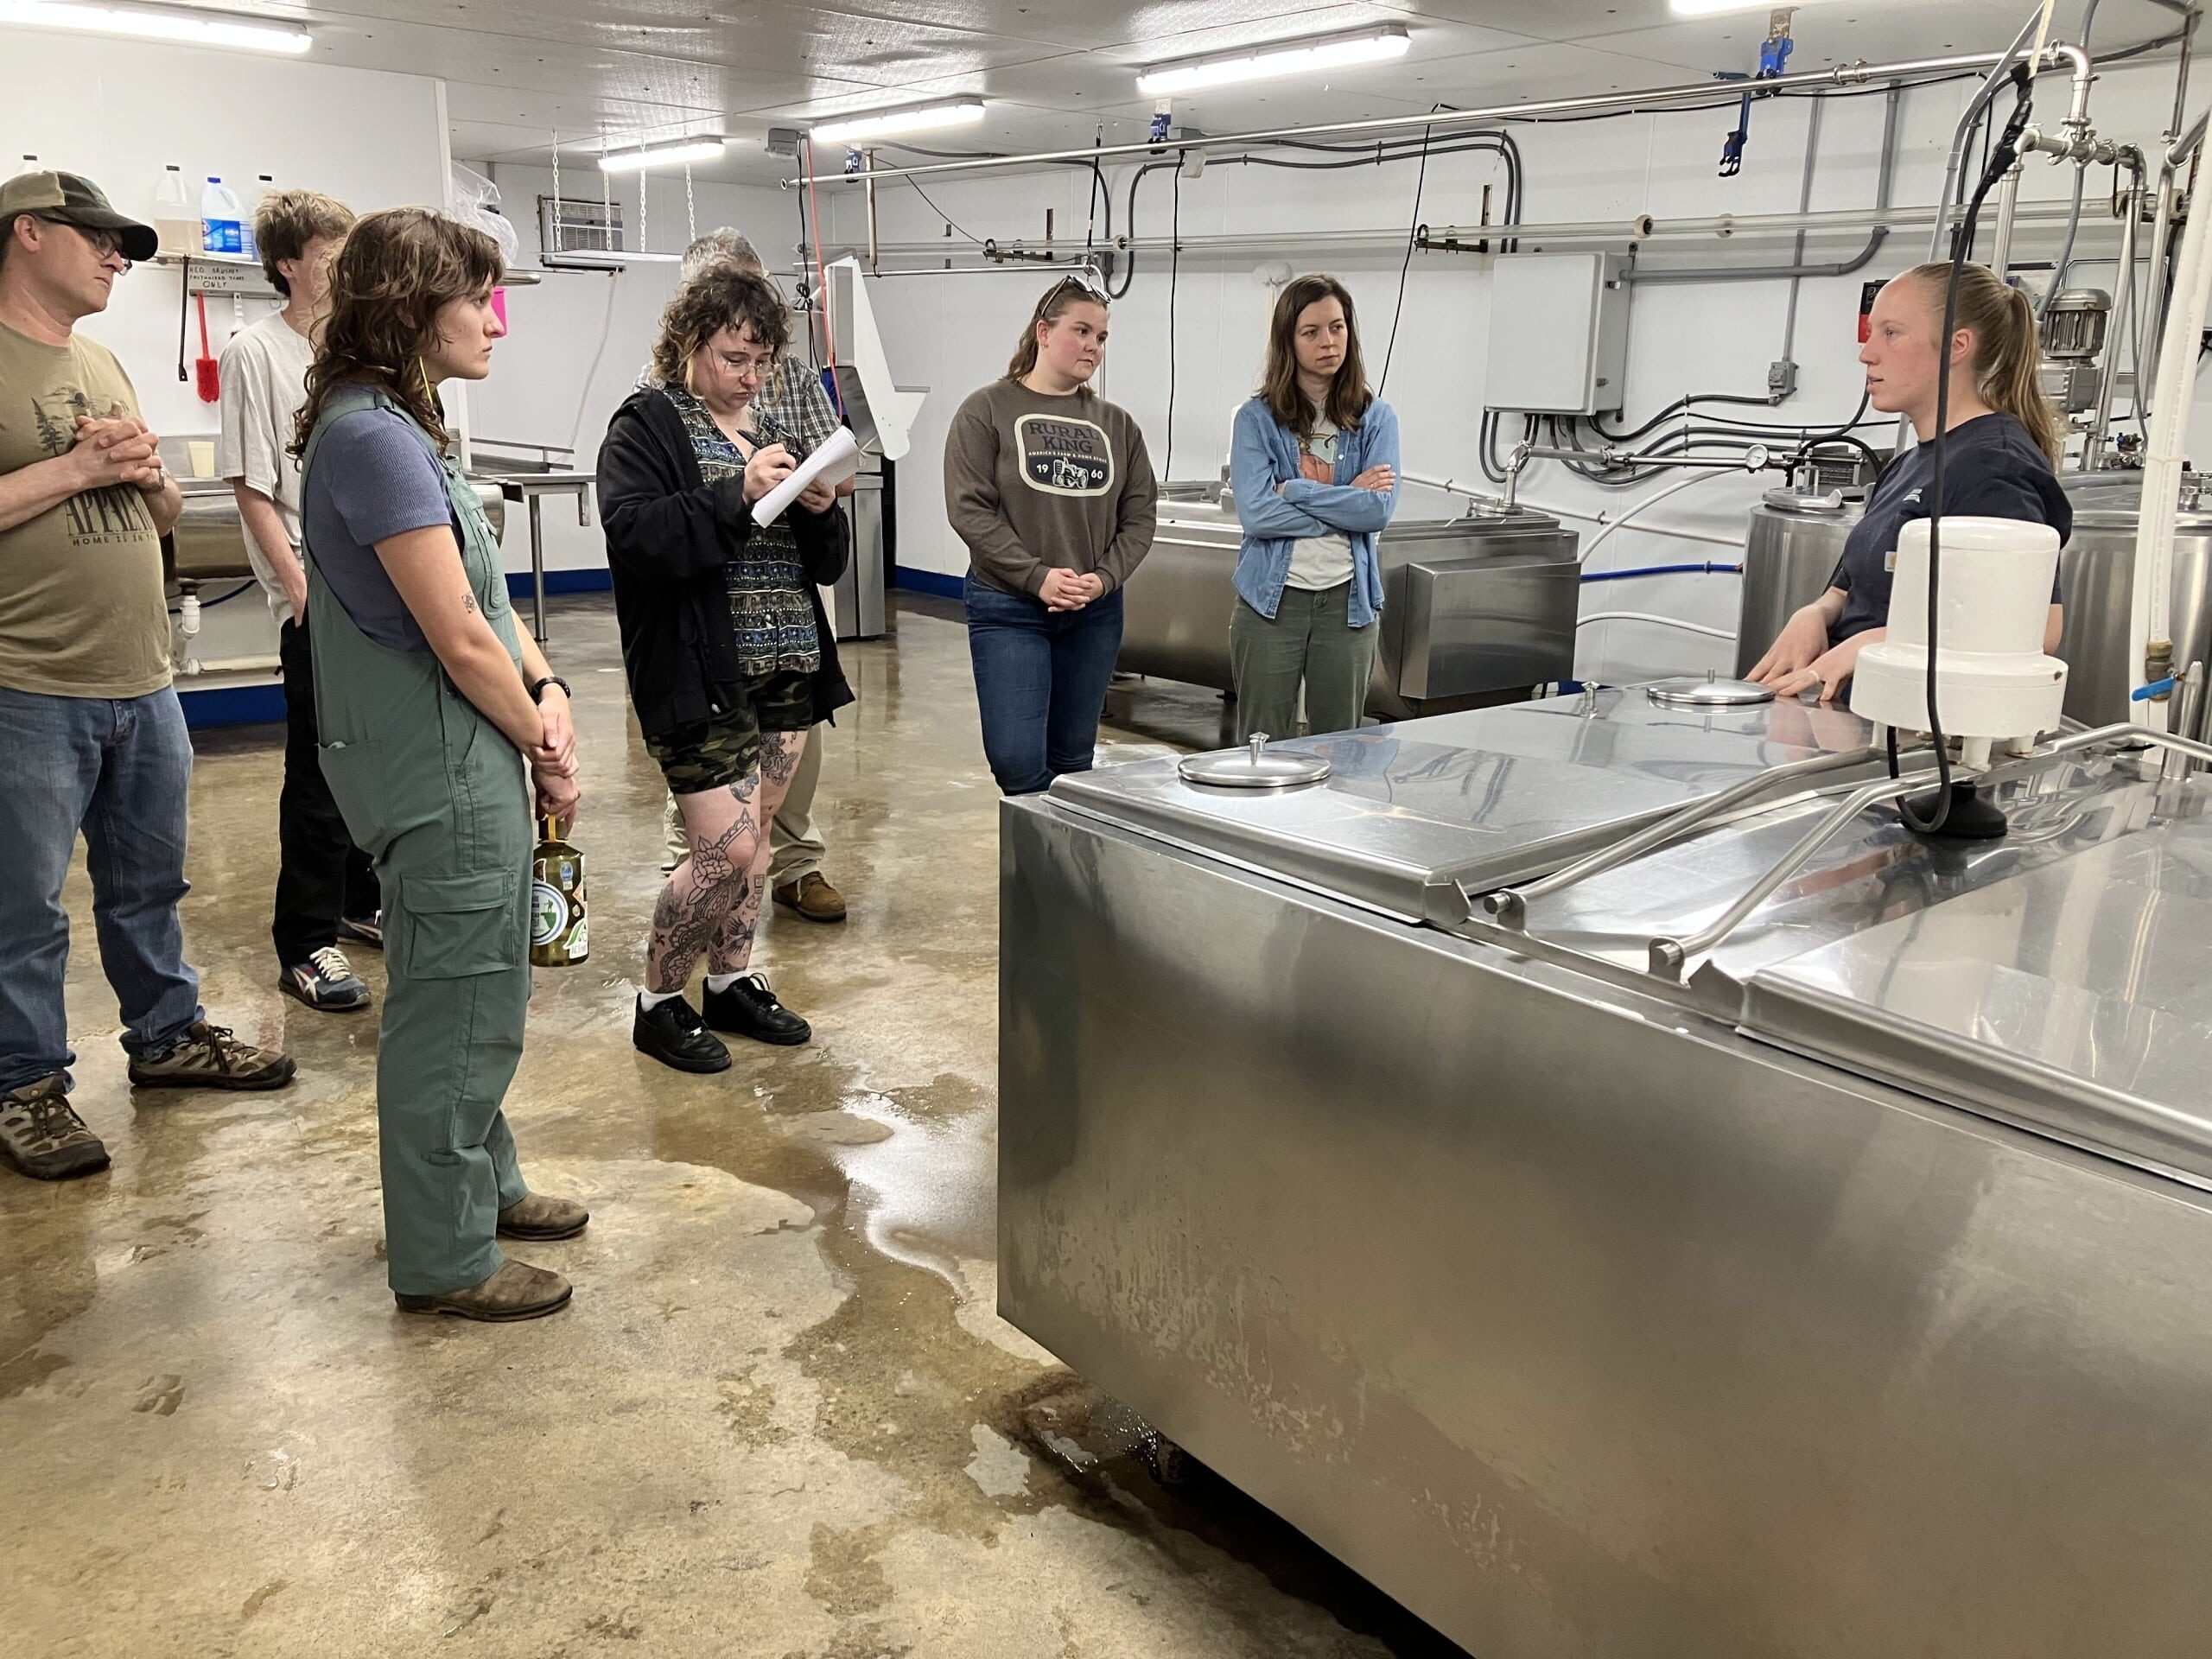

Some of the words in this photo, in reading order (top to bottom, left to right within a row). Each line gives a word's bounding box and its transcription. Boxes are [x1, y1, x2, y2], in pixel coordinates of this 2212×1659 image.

[202, 280, 227, 289] ONLY
[1028, 422, 1100, 441] RURAL
[1042, 435, 1093, 454] KING
[1036, 464, 1049, 474] 19
[1090, 469, 1103, 480] 60
[73, 537, 110, 547] HOME
